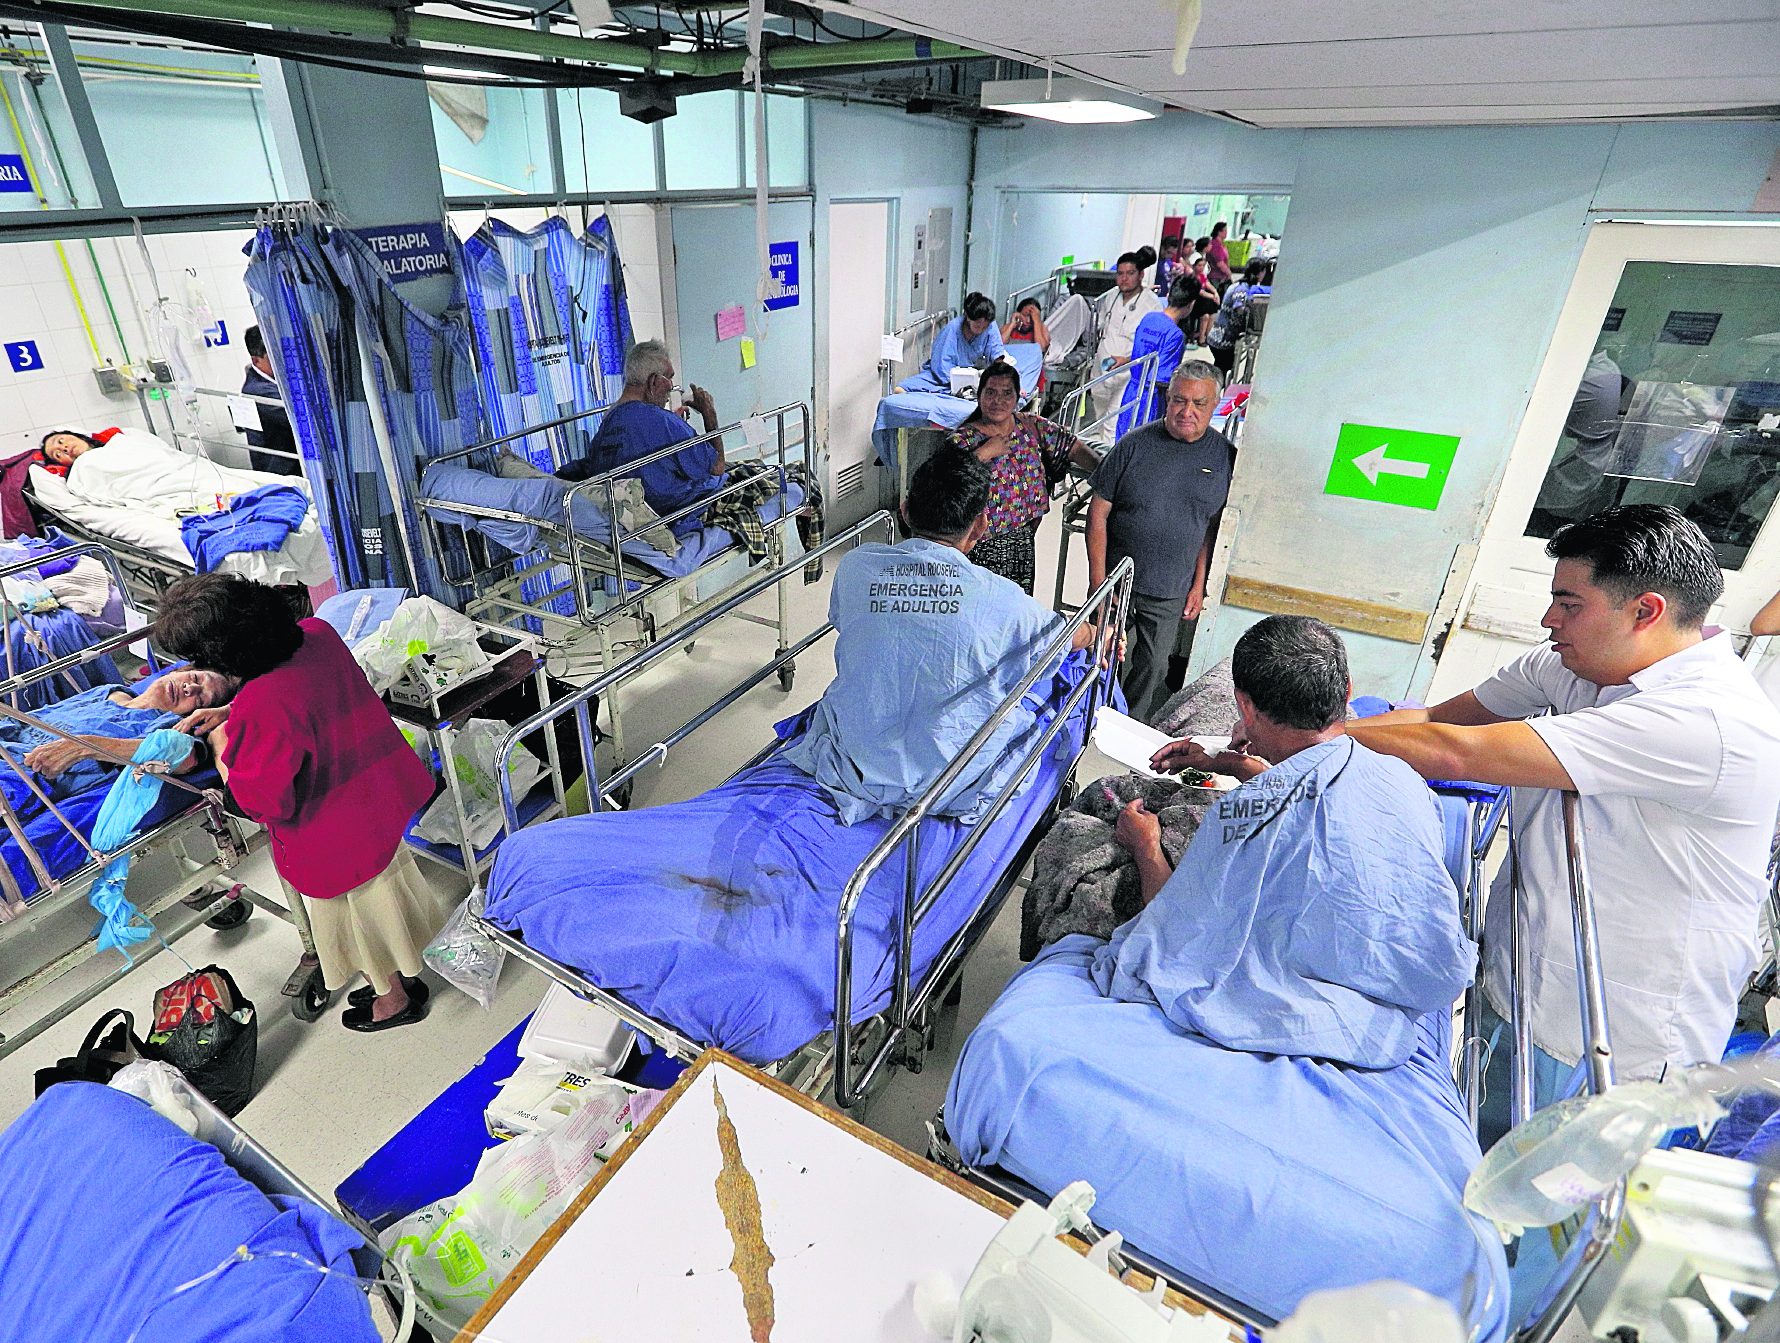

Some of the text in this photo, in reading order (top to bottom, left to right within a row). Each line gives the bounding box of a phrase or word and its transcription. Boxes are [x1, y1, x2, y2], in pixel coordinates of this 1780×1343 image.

[368, 232, 430, 253] TERAPIA
[771, 253, 792, 267] CLINICA
[778, 270, 785, 281] DE
[17, 345, 33, 367] 3
[896, 563, 926, 577] HOSPITAL
[869, 583, 964, 598] EMERGENCIA
[870, 600, 960, 614] DE ADULTOS
[1222, 823, 1249, 845] DE
